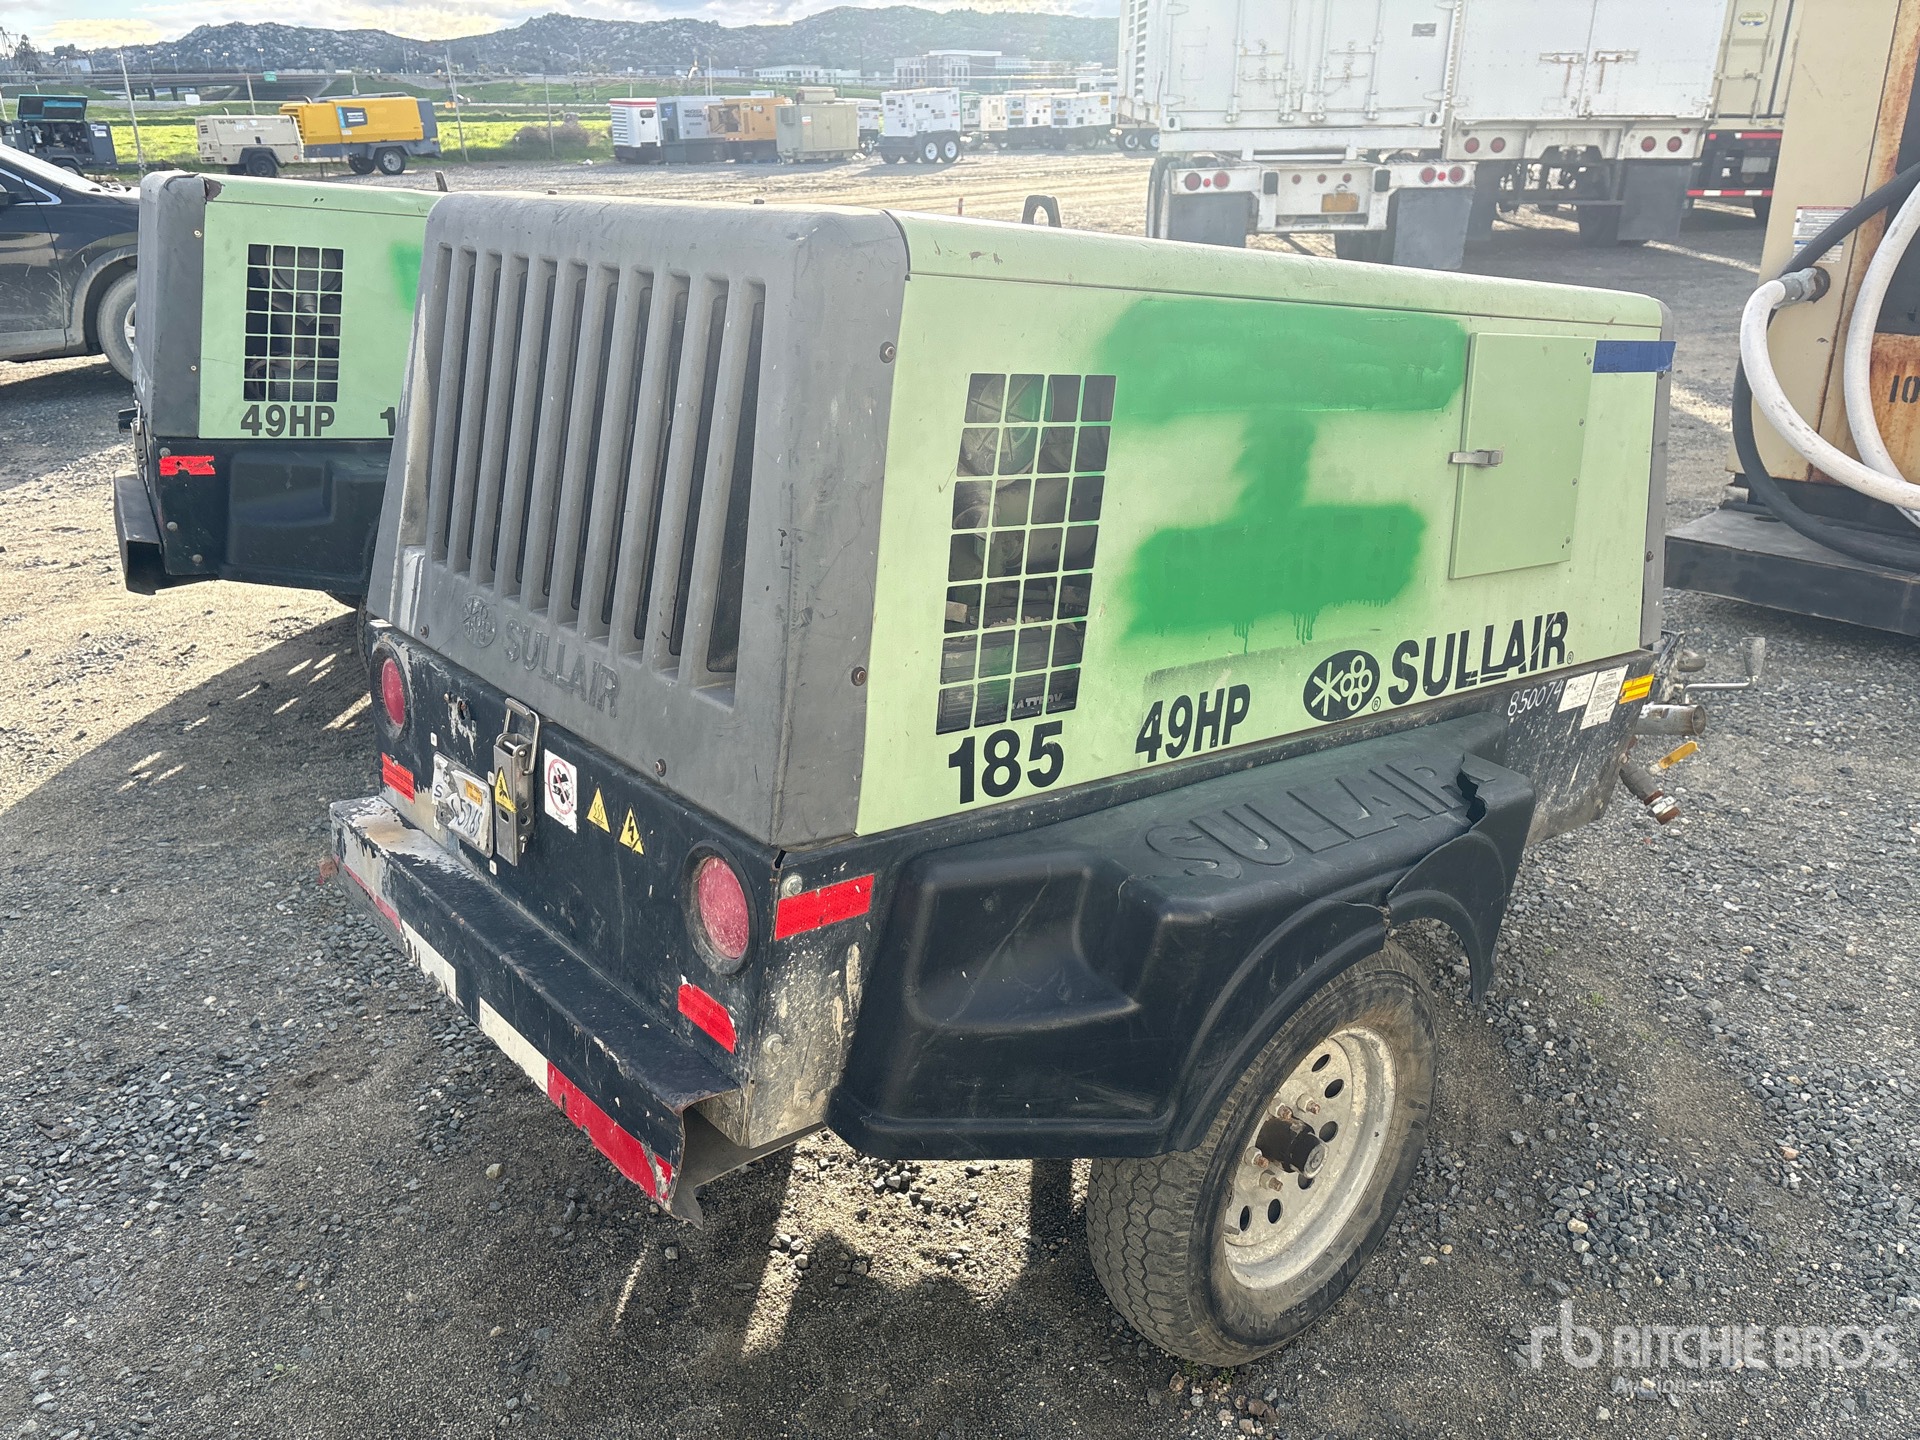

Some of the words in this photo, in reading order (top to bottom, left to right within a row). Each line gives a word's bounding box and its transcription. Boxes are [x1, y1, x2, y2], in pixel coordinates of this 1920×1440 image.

[240, 404, 335, 437] 49HP
[505, 619, 618, 719] SULLAIR
[1388, 611, 1569, 705] SULLAIR
[1507, 679, 1564, 716] 850074
[948, 720, 1064, 804] 185
[1134, 684, 1251, 763] 49HP
[1144, 755, 1473, 879] SULLAIR
